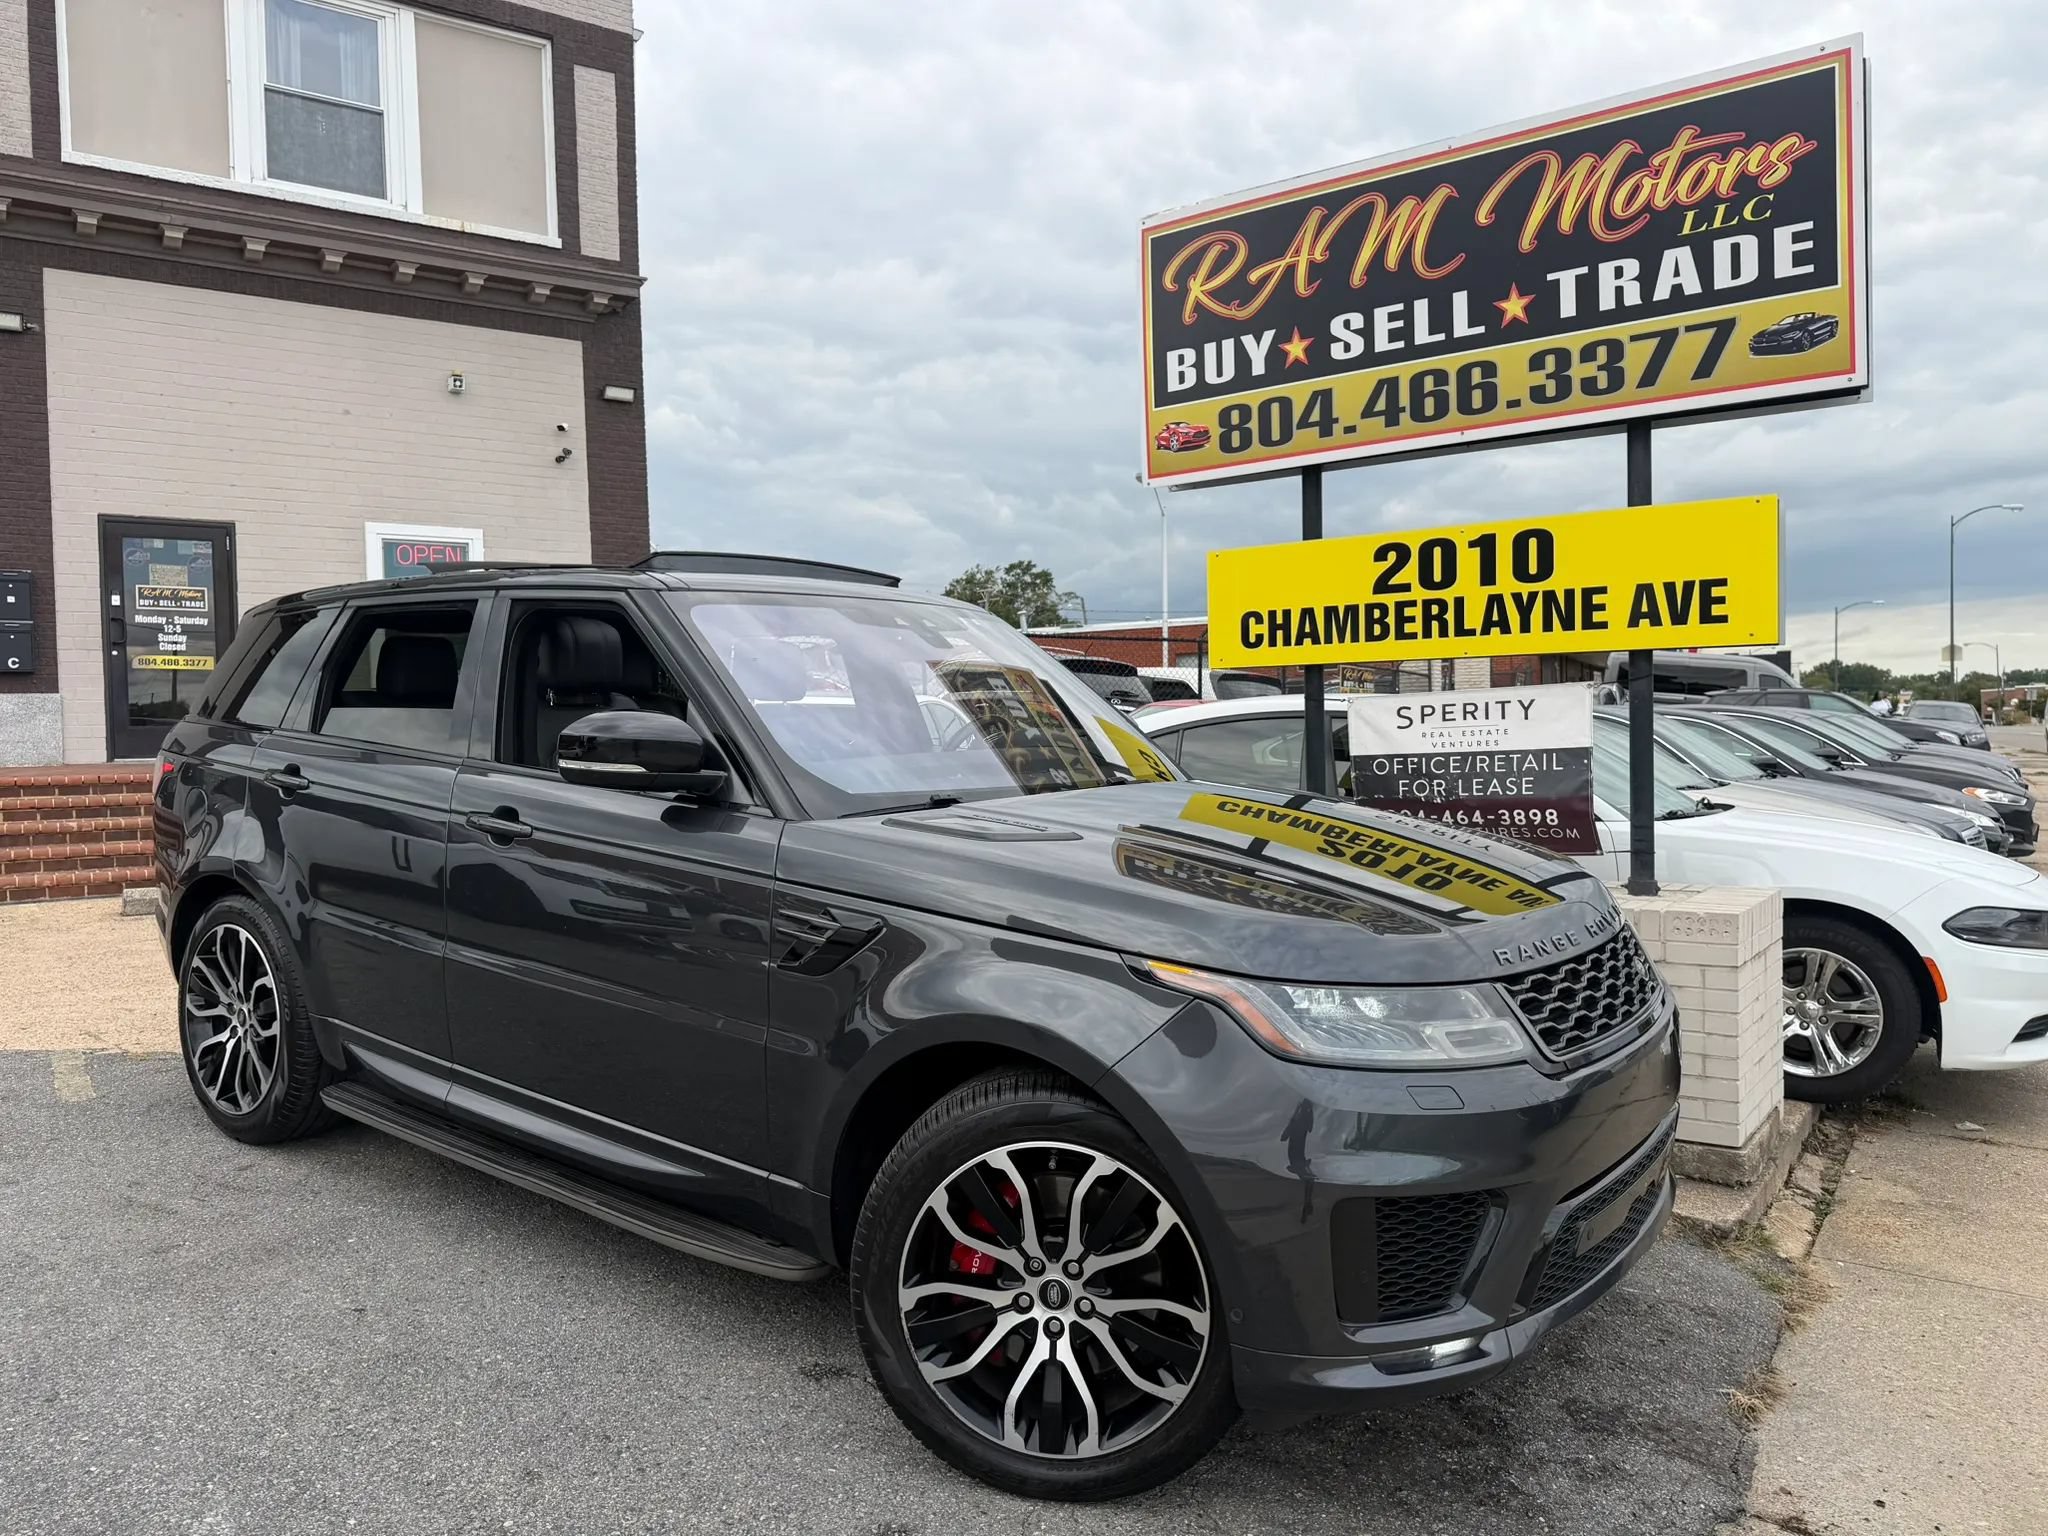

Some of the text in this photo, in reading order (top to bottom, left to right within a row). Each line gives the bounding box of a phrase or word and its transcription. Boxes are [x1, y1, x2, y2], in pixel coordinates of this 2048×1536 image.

[1475, 125, 1817, 254] Motors
[1676, 193, 1776, 237] LLC
[1165, 220, 1815, 394] BUY SELL TRADE
[1216, 314, 1743, 456] 804.466.3377
[396, 544, 462, 566] OPEN
[1371, 528, 1556, 595] 2010
[181, 600, 205, 608] TRADE
[1240, 577, 1730, 650] CHAMBERLAYNE AVE
[135, 615, 167, 624] Monday
[173, 616, 209, 626] Saturday
[163, 625, 182, 633] 12-5
[158, 633, 187, 642] Sunday
[159, 642, 187, 651] Closed
[7, 657, 20, 669] C
[1396, 698, 1536, 730] SPERITY
[1421, 728, 1510, 739] REAL ESTATE
[1431, 739, 1501, 749] VENTURES
[1372, 752, 1565, 775] OFFICE/RETAIL
[1398, 777, 1535, 798] FOR LEASE
[1384, 808, 1560, 827] 4-464-3898
[1493, 930, 1581, 967] RANGE
[970, 1250, 983, 1274] ROV
